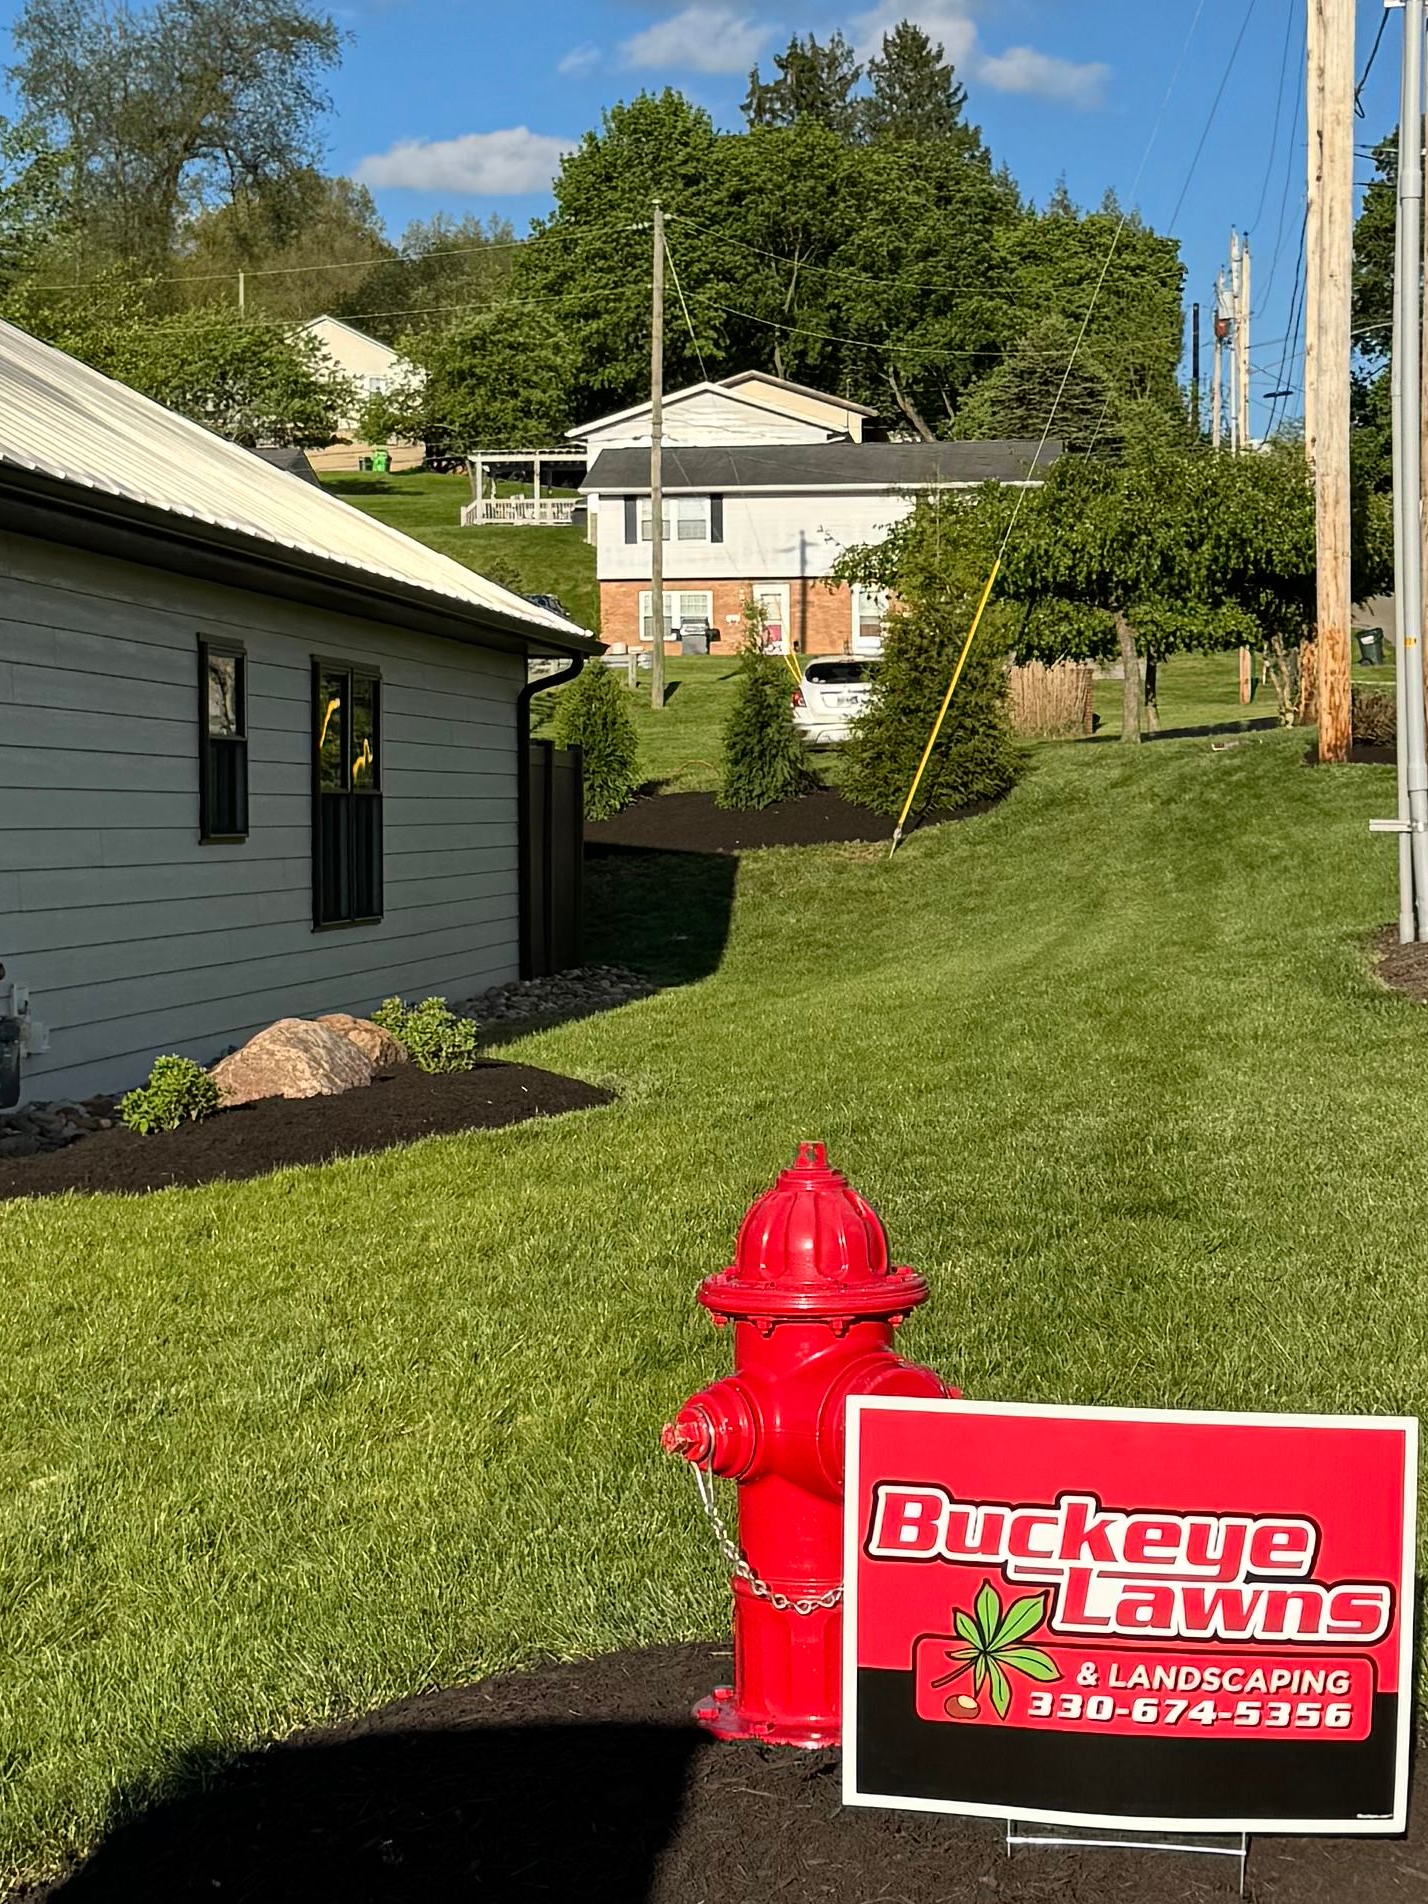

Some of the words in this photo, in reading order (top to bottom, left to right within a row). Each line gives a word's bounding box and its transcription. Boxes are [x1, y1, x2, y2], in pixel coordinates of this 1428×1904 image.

[870, 1487, 1314, 1584] Buckeye
[1054, 1562, 1392, 1639] Lawns
[1076, 1661, 1100, 1687] &
[1108, 1662, 1351, 1695] LANDSCAPING
[1027, 1691, 1353, 1729] 330-674-5356
